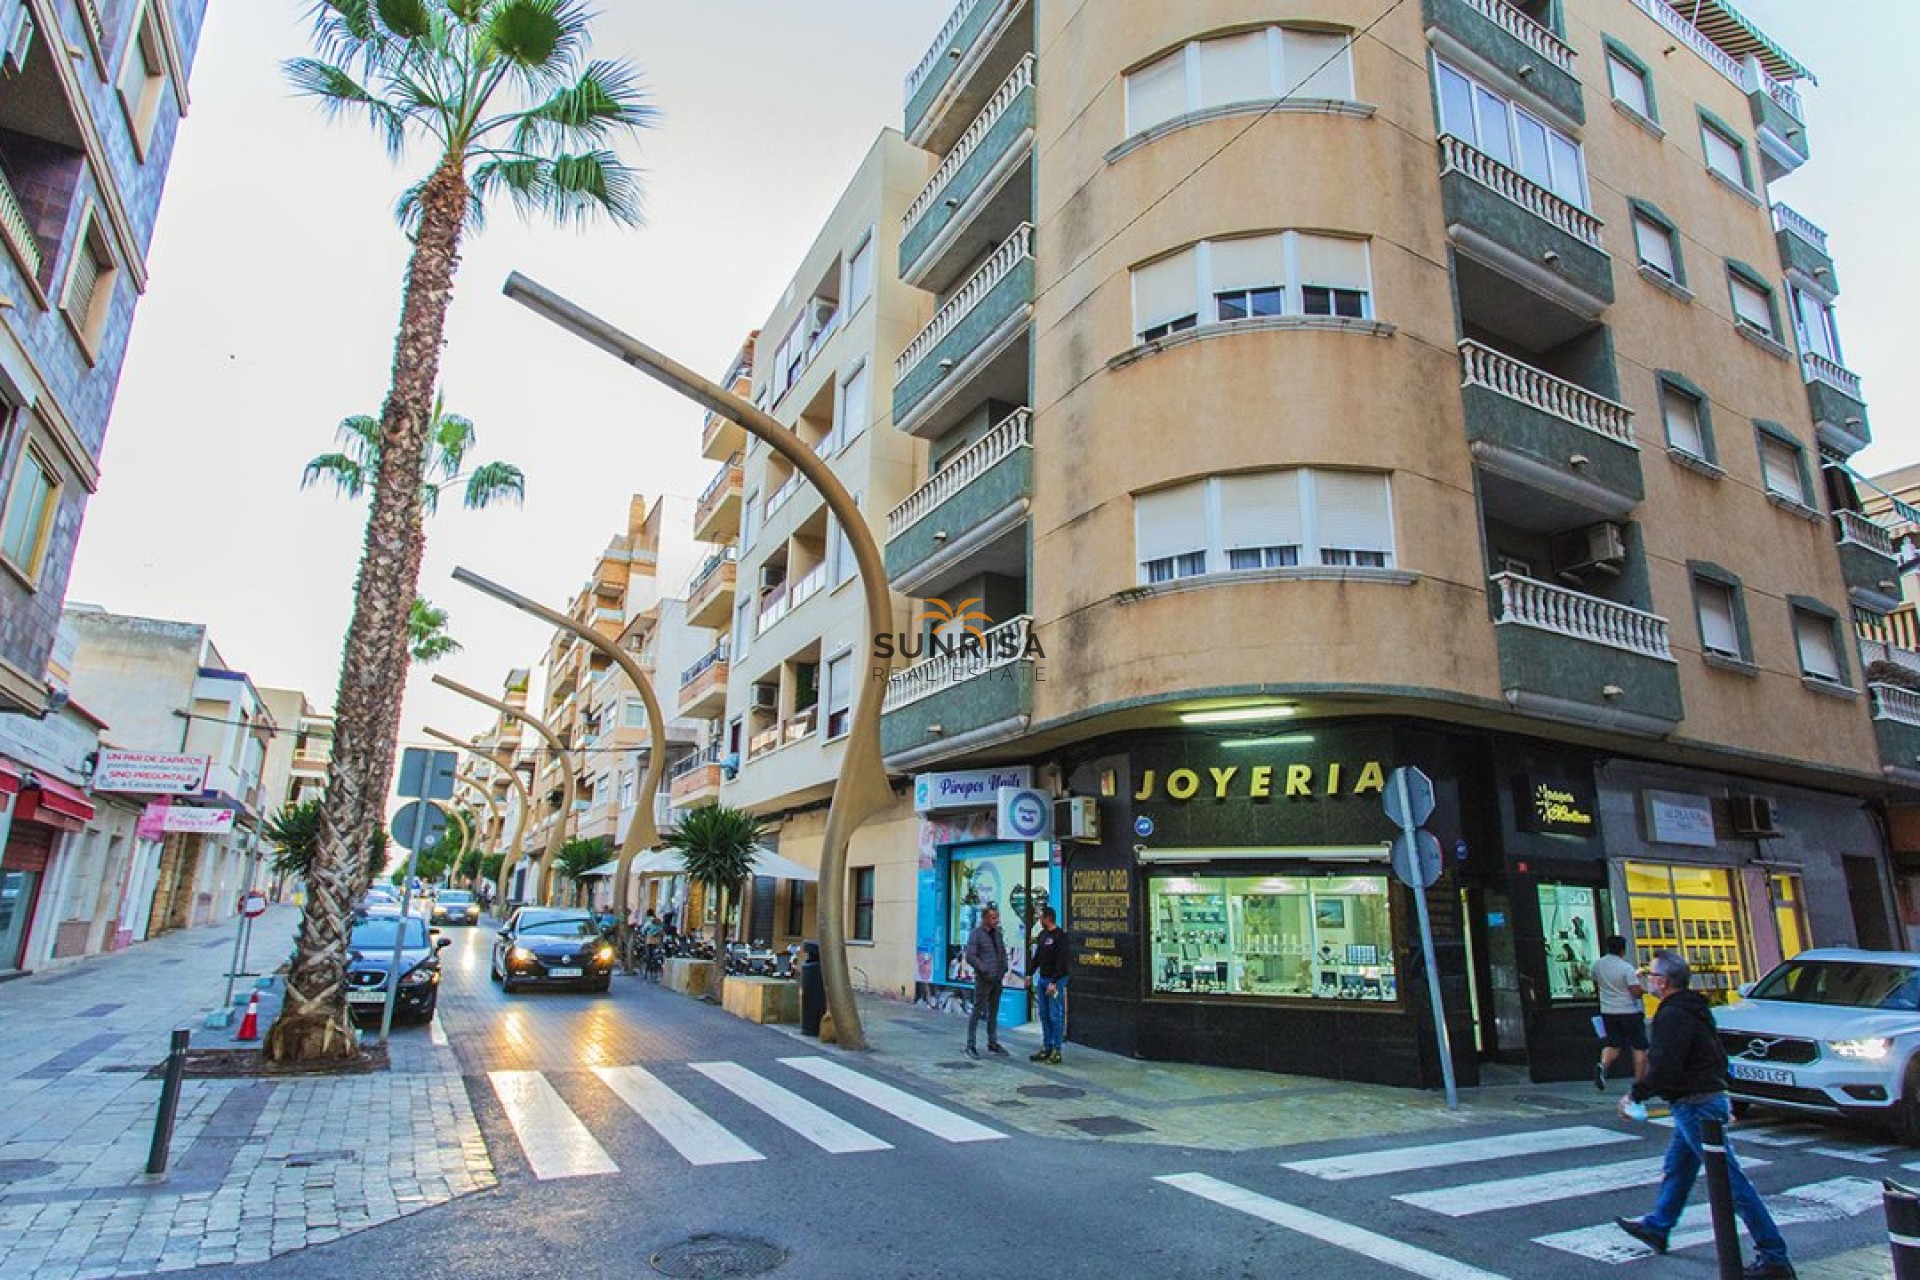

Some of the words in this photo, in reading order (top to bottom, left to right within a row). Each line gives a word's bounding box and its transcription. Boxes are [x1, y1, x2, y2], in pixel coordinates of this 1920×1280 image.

[159, 755, 203, 764] ZAPATOS
[1134, 761, 1385, 800] JOYERIA
[1072, 870, 1108, 891] COMPRO
[1109, 869, 1128, 891] ORO
